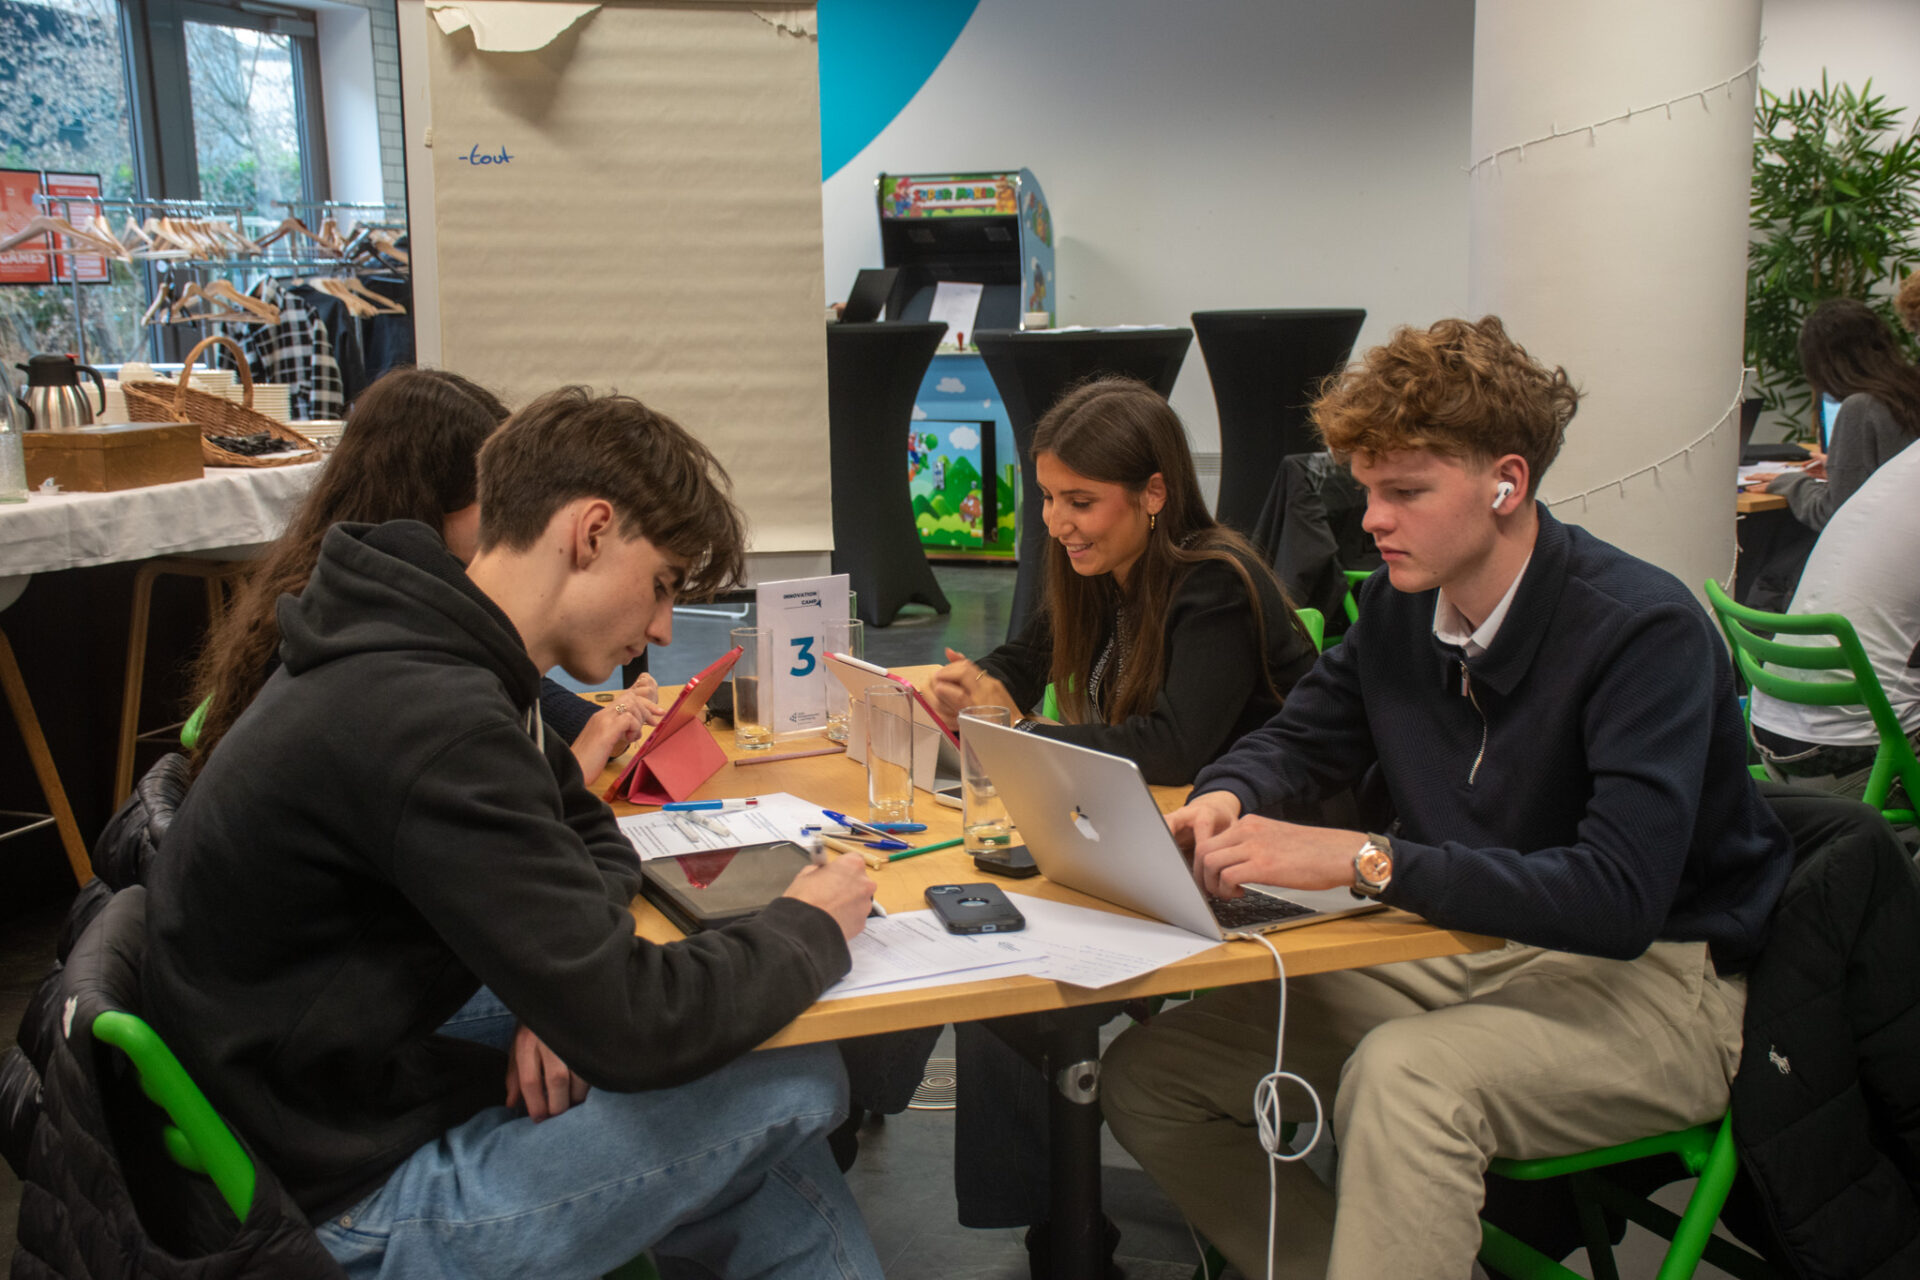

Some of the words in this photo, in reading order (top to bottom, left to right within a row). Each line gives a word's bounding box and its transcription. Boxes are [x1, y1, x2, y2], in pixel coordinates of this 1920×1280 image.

[914, 188, 952, 200] SUPER
[956, 186, 996, 200] MARIO
[783, 591, 817, 599] INNOVATION
[790, 636, 816, 677] 3
